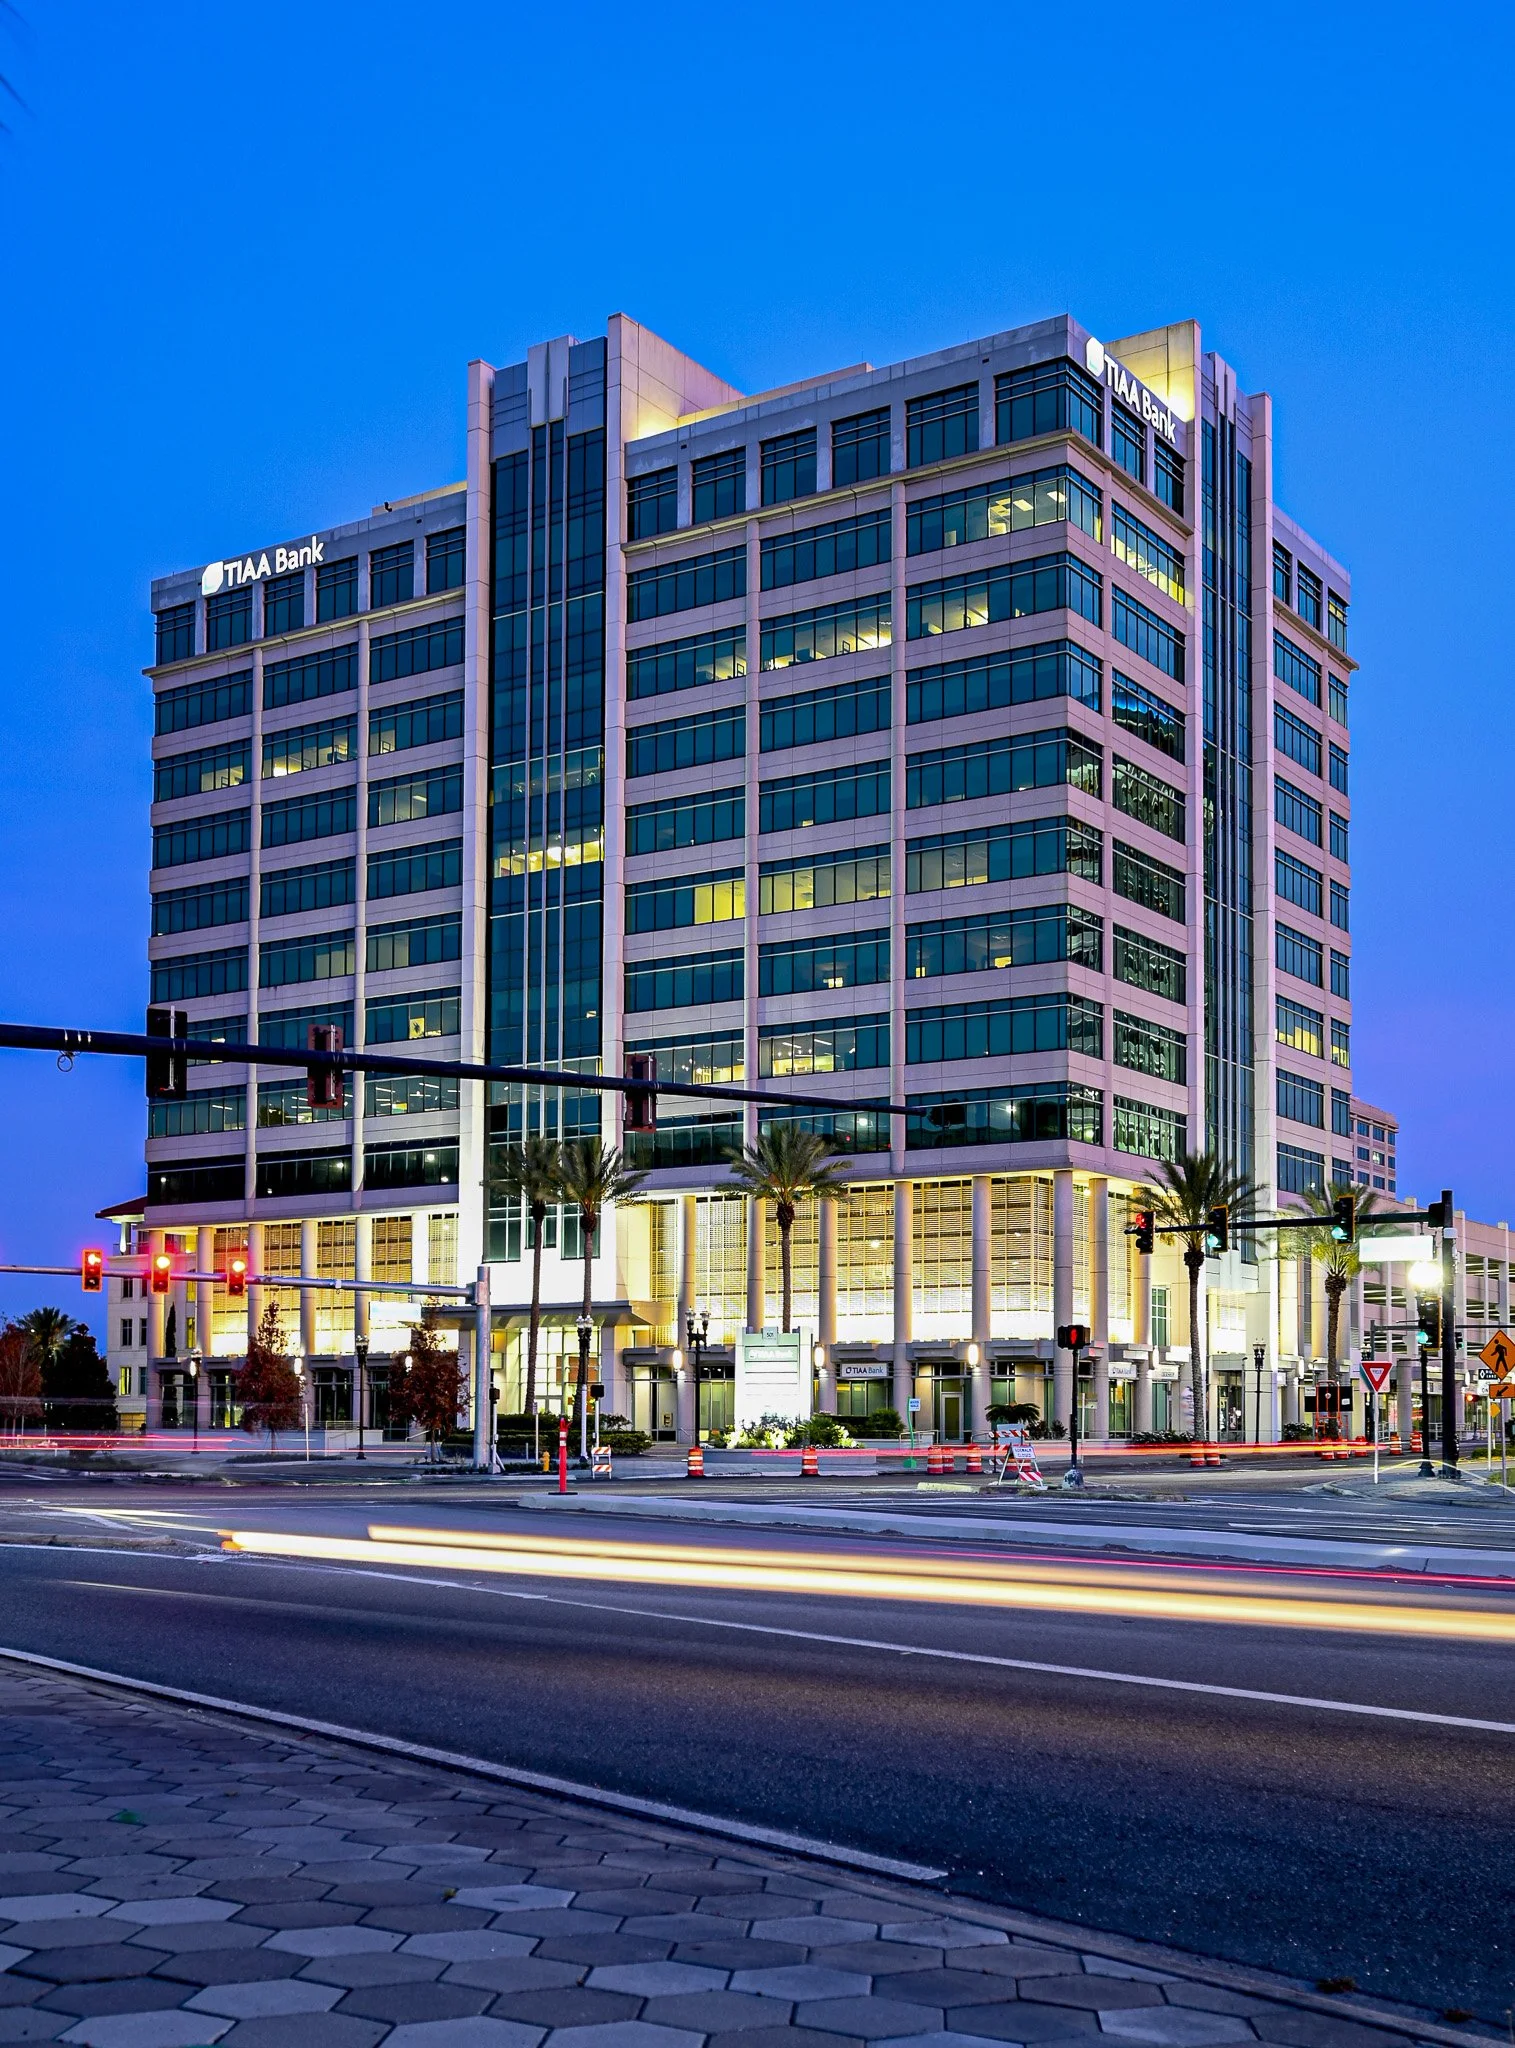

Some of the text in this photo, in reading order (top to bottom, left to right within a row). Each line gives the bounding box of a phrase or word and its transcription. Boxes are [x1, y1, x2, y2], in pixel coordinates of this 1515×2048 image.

[1104, 353, 1176, 444] TIAA Bank
[224, 535, 324, 587] TIAA Bank
[868, 1366, 884, 1374] Bank
